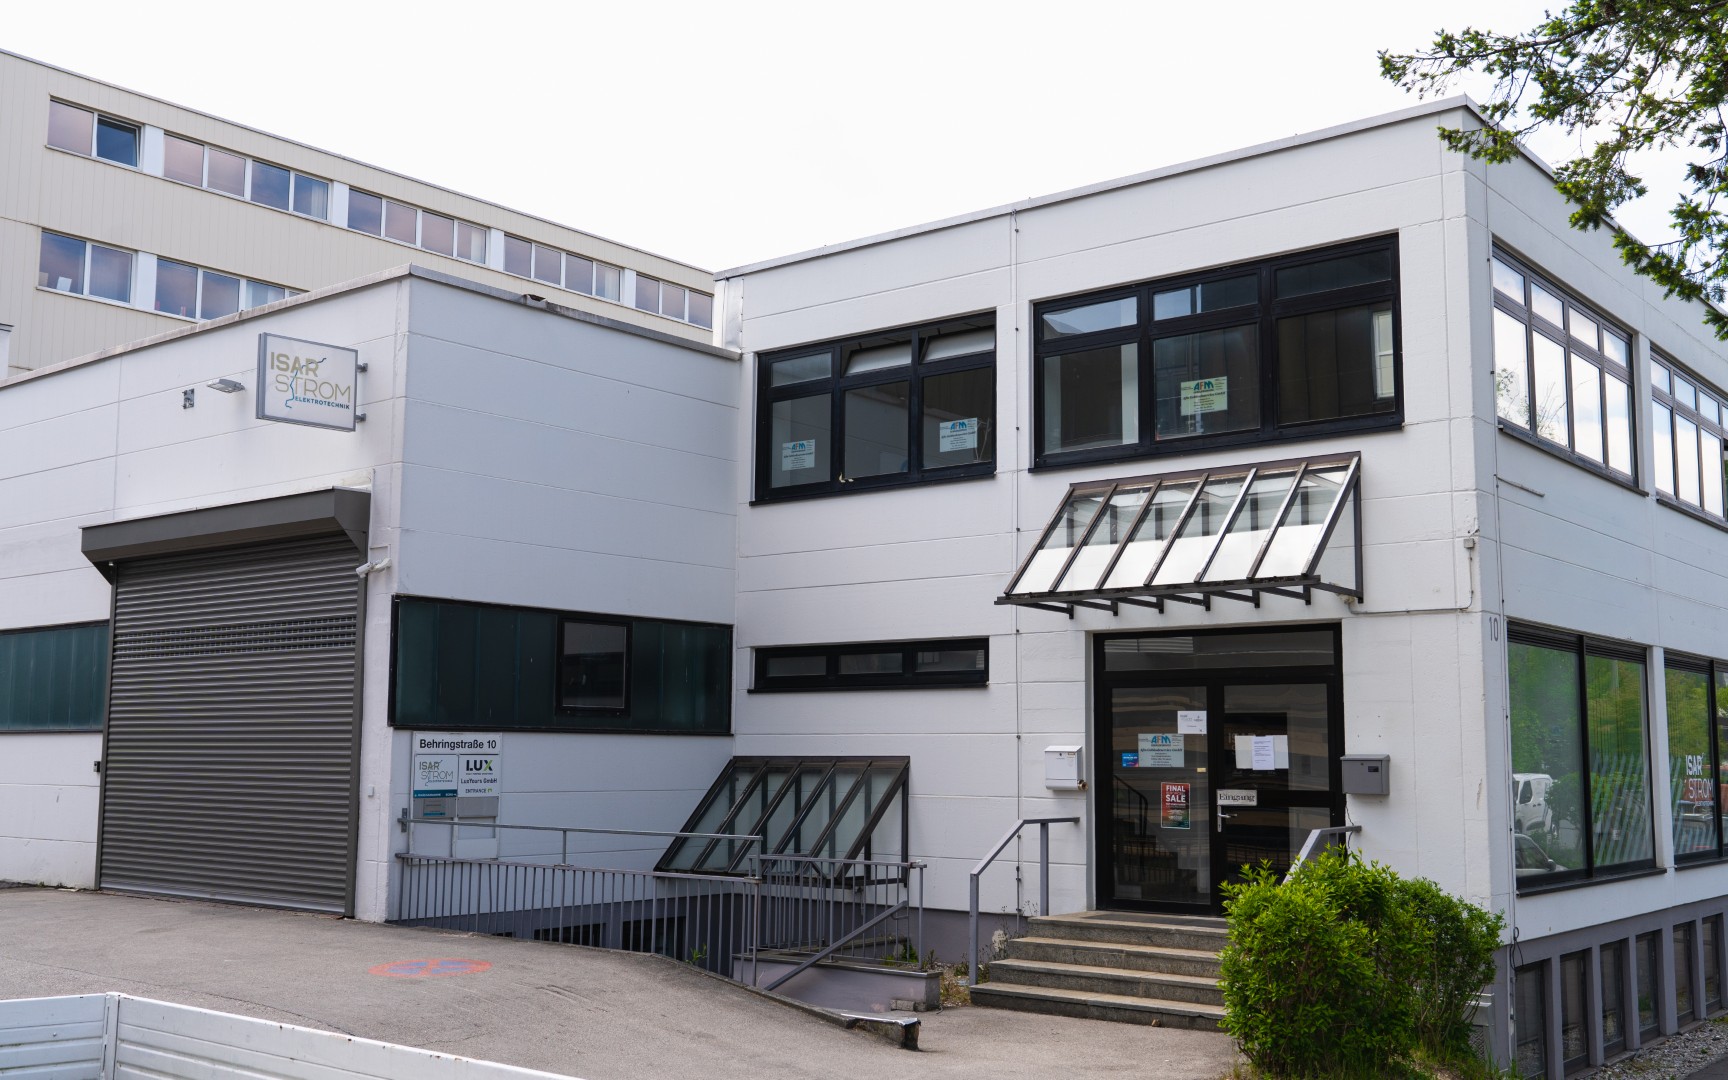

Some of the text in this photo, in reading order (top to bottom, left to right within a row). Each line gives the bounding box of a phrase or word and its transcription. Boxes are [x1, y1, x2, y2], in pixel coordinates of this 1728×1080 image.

[270, 351, 319, 377] ISAR
[275, 373, 351, 403] STROM
[1193, 380, 1214, 391] AFM
[295, 396, 350, 409] ELEKTROTECHNIK
[950, 421, 967, 430] AFM
[791, 442, 806, 450] AFM
[1489, 617, 1499, 642] 10
[419, 738, 497, 751] Behringstraße 10
[1151, 735, 1171, 744] AFM
[419, 761, 440, 771] ISAR
[466, 759, 493, 772] LUX
[1685, 754, 1703, 776] ISAR
[420, 770, 454, 780] STROM
[1165, 784, 1186, 793] FINAL
[1688, 778, 1714, 799] STROM
[1165, 794, 1186, 803] SALE
[1219, 793, 1256, 802] Eingang
